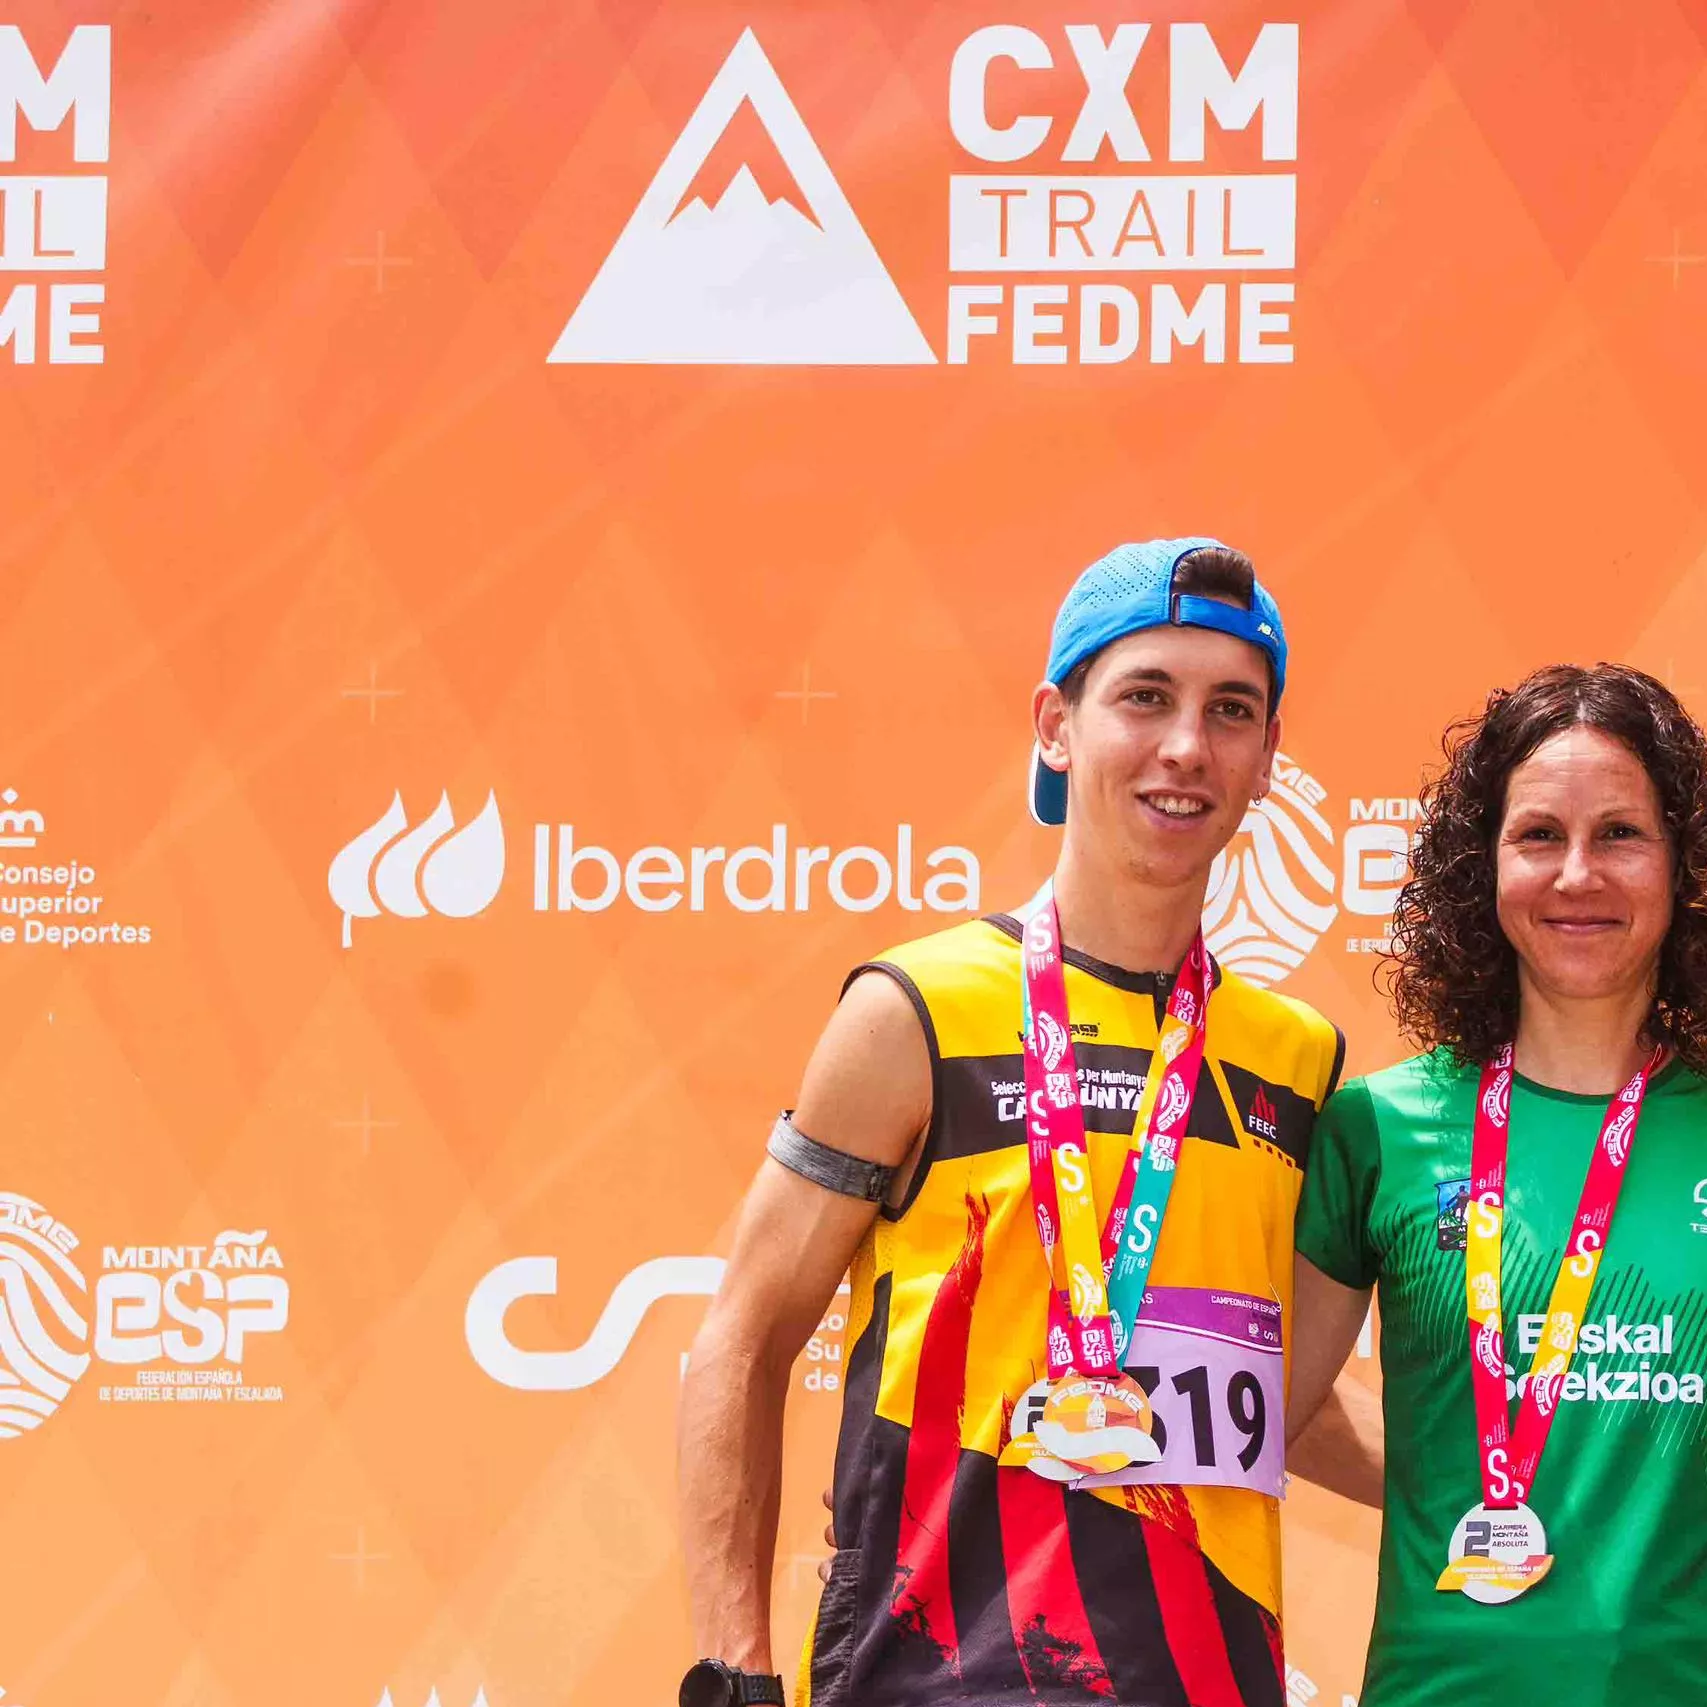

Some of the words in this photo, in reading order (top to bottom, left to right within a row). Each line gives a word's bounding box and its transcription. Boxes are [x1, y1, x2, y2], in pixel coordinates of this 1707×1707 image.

[947, 22, 1299, 162] CXM
[978, 187, 1265, 258] TRAIL
[947, 284, 1297, 364] FEDME
[0, 861, 95, 889] onsejo
[533, 823, 981, 914] Iberdrola
[2, 890, 103, 918] uperior
[24, 920, 152, 949] Deportes
[1248, 1114, 1278, 1140] FEEC
[102, 1229, 284, 1269] MONTAÑA
[1517, 1313, 1674, 1354] Eskal
[804, 1368, 839, 1391] de
[1464, 1520, 1492, 1559] 2
